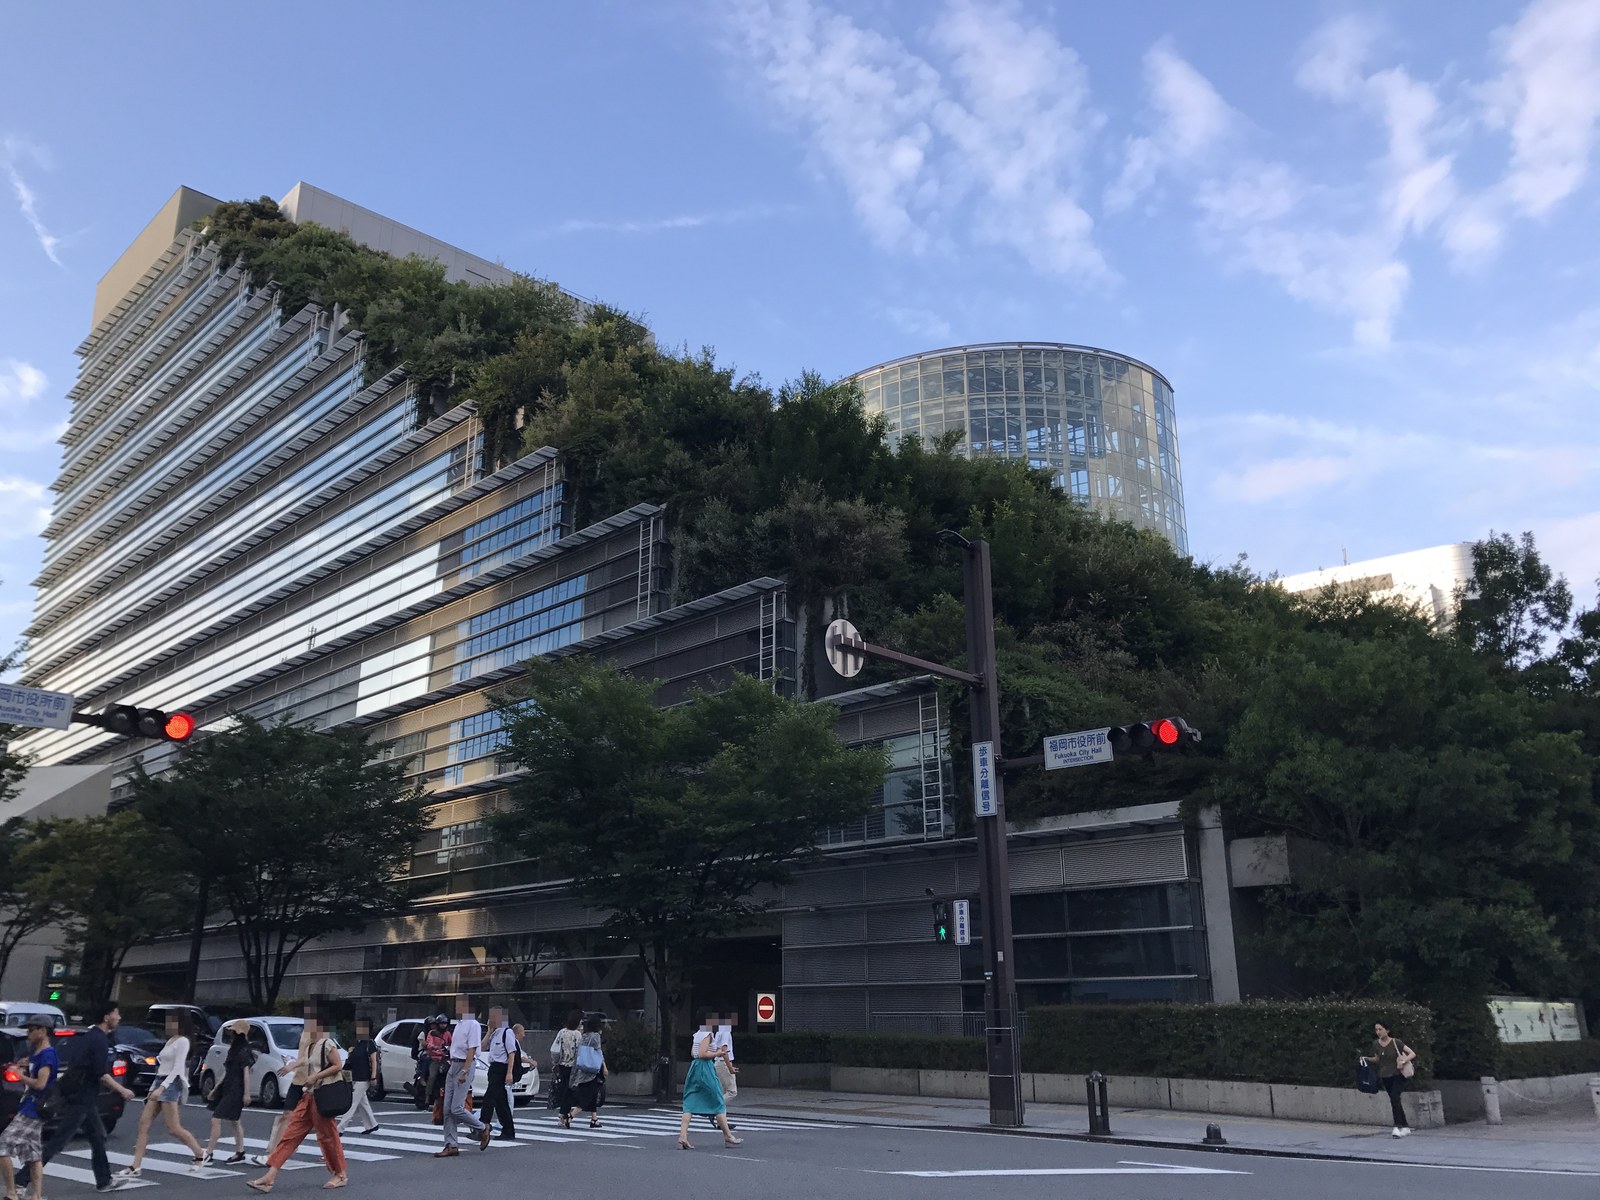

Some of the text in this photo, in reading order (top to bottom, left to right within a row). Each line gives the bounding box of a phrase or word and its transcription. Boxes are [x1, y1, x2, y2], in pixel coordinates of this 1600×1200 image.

[1049, 733, 1106, 752] 福岡市役所前
[1063, 756, 1094, 764] INTERSECTION
[978, 746, 991, 812] 歩車分離信号
[52, 963, 64, 977] P
